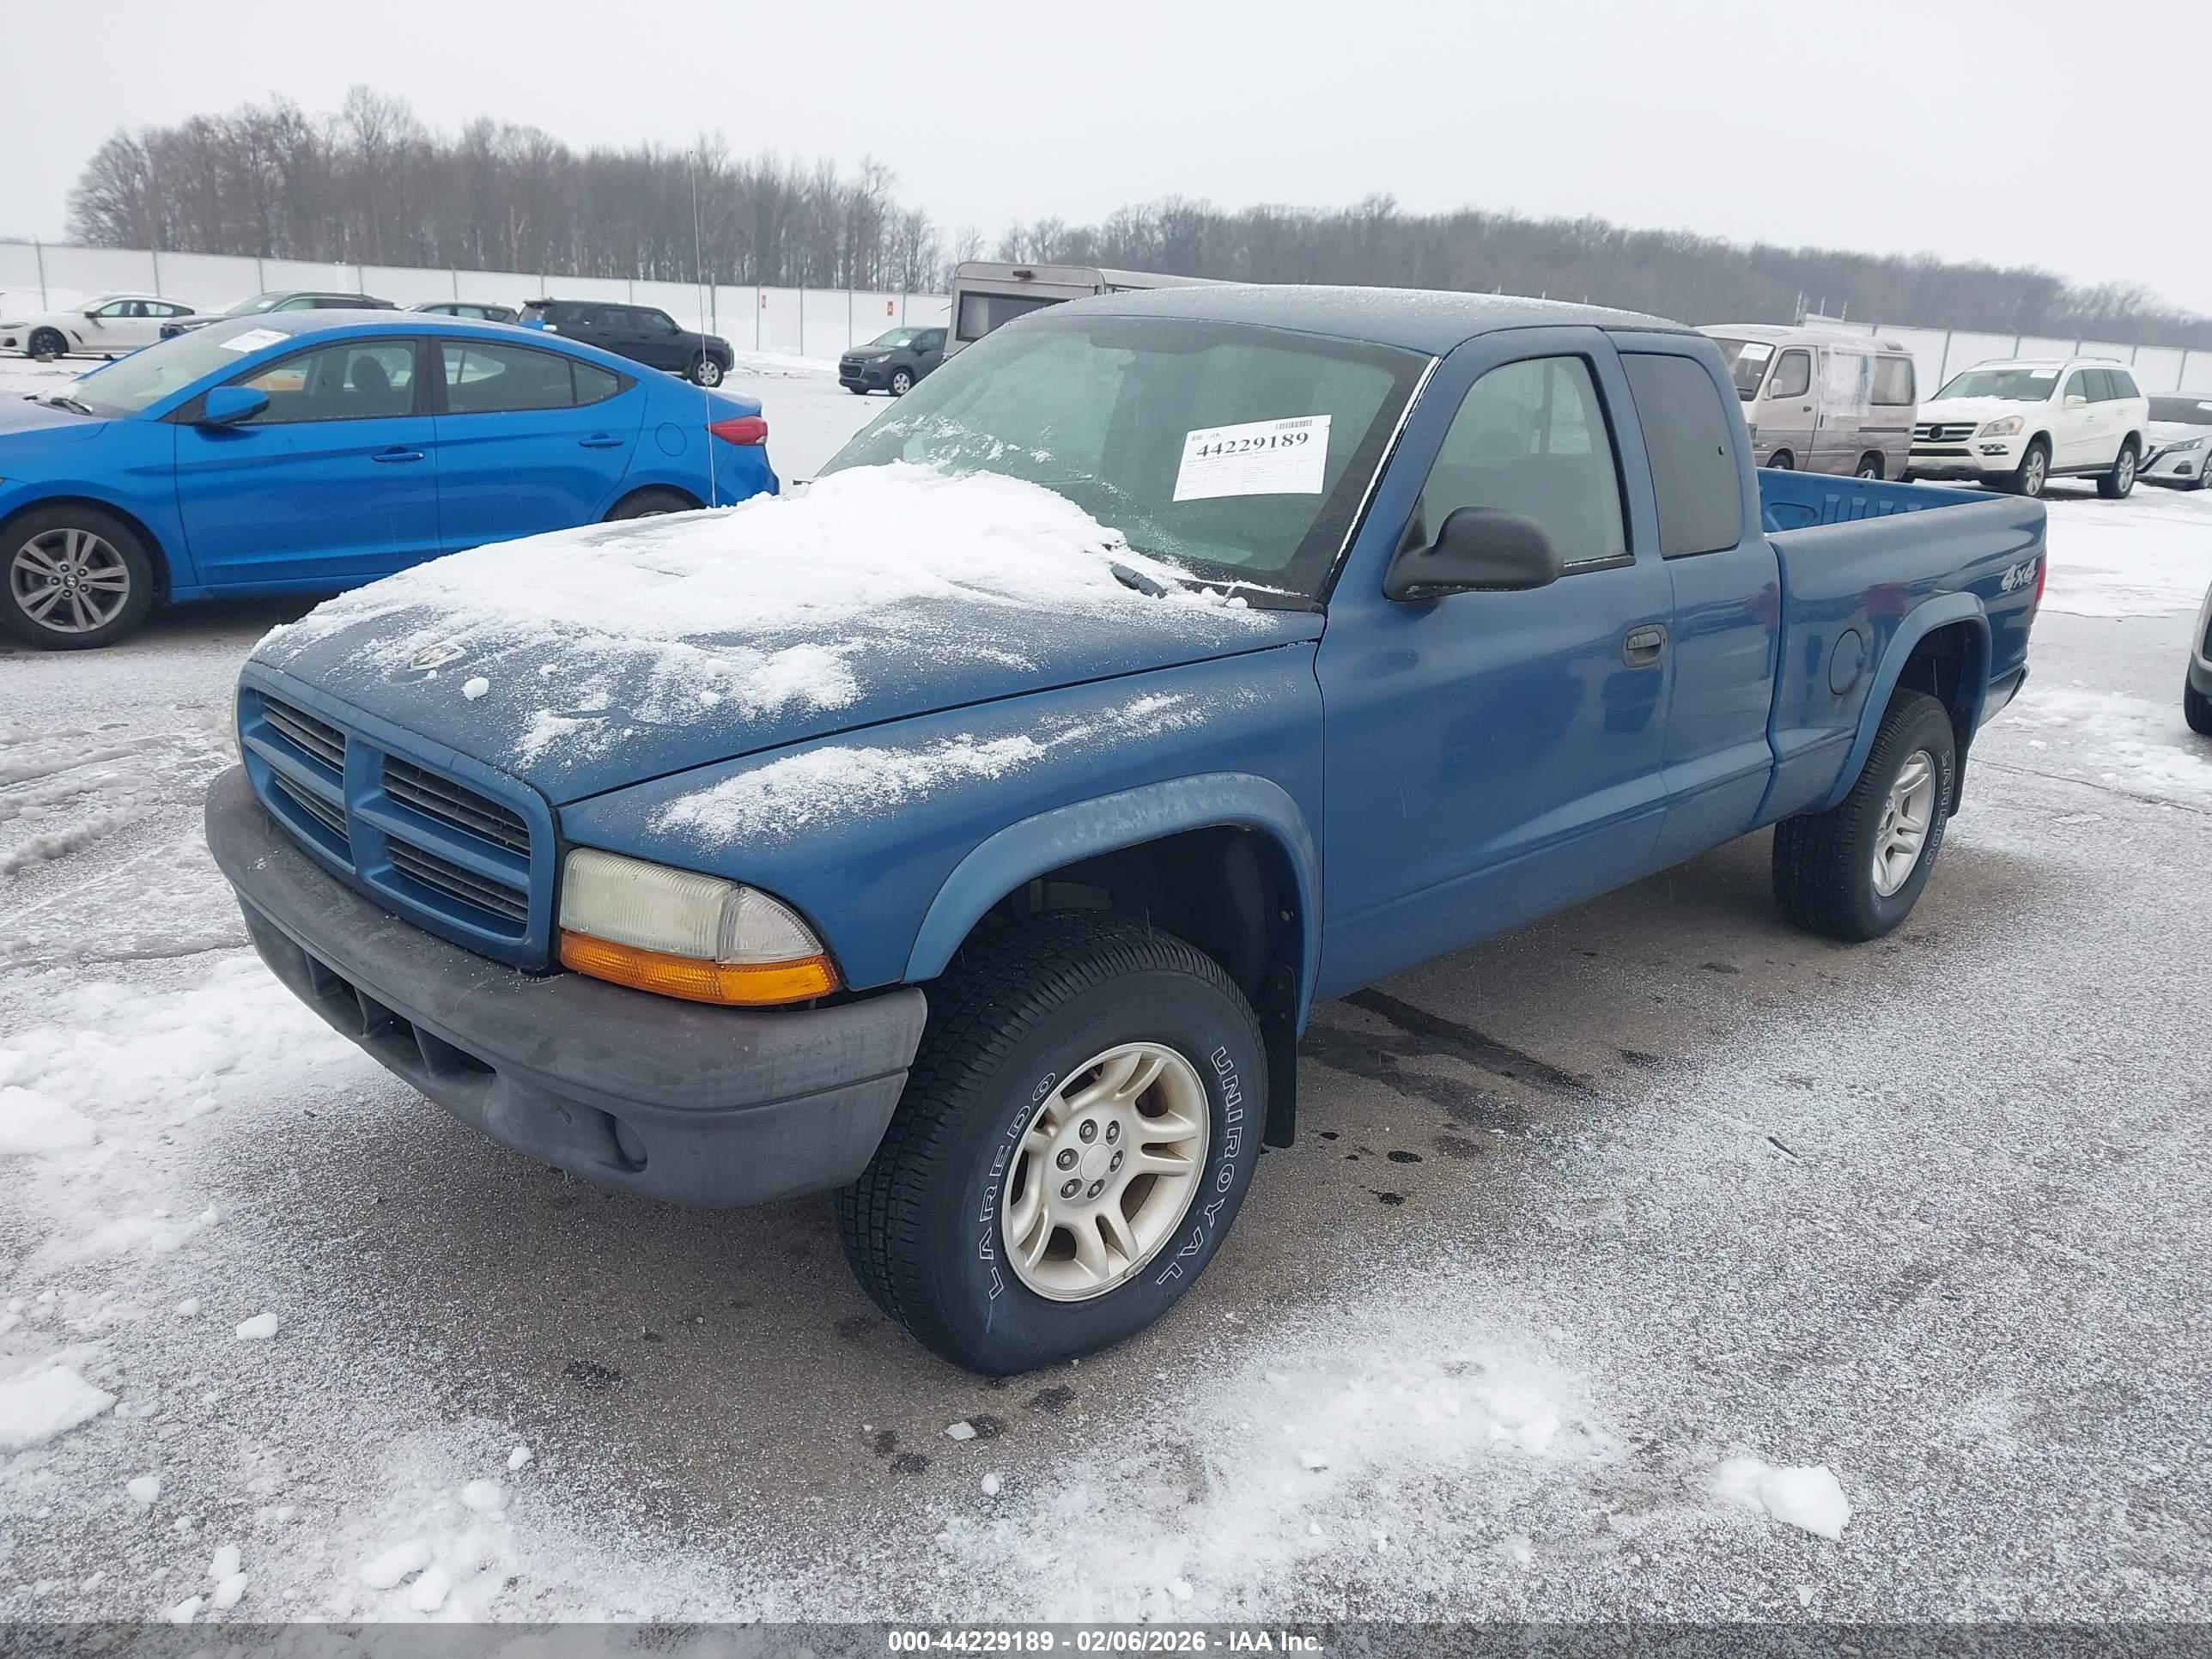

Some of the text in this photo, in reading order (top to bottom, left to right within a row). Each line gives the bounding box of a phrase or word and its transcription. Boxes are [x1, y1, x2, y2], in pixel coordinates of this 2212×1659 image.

[1196, 432, 1310, 458] 44229189
[2001, 557, 2037, 592] 4x4
[1925, 750, 1953, 866] LAREDO
[978, 1071, 1057, 1301] LAREDO
[1156, 1046, 1244, 1287] UNIROYAL
